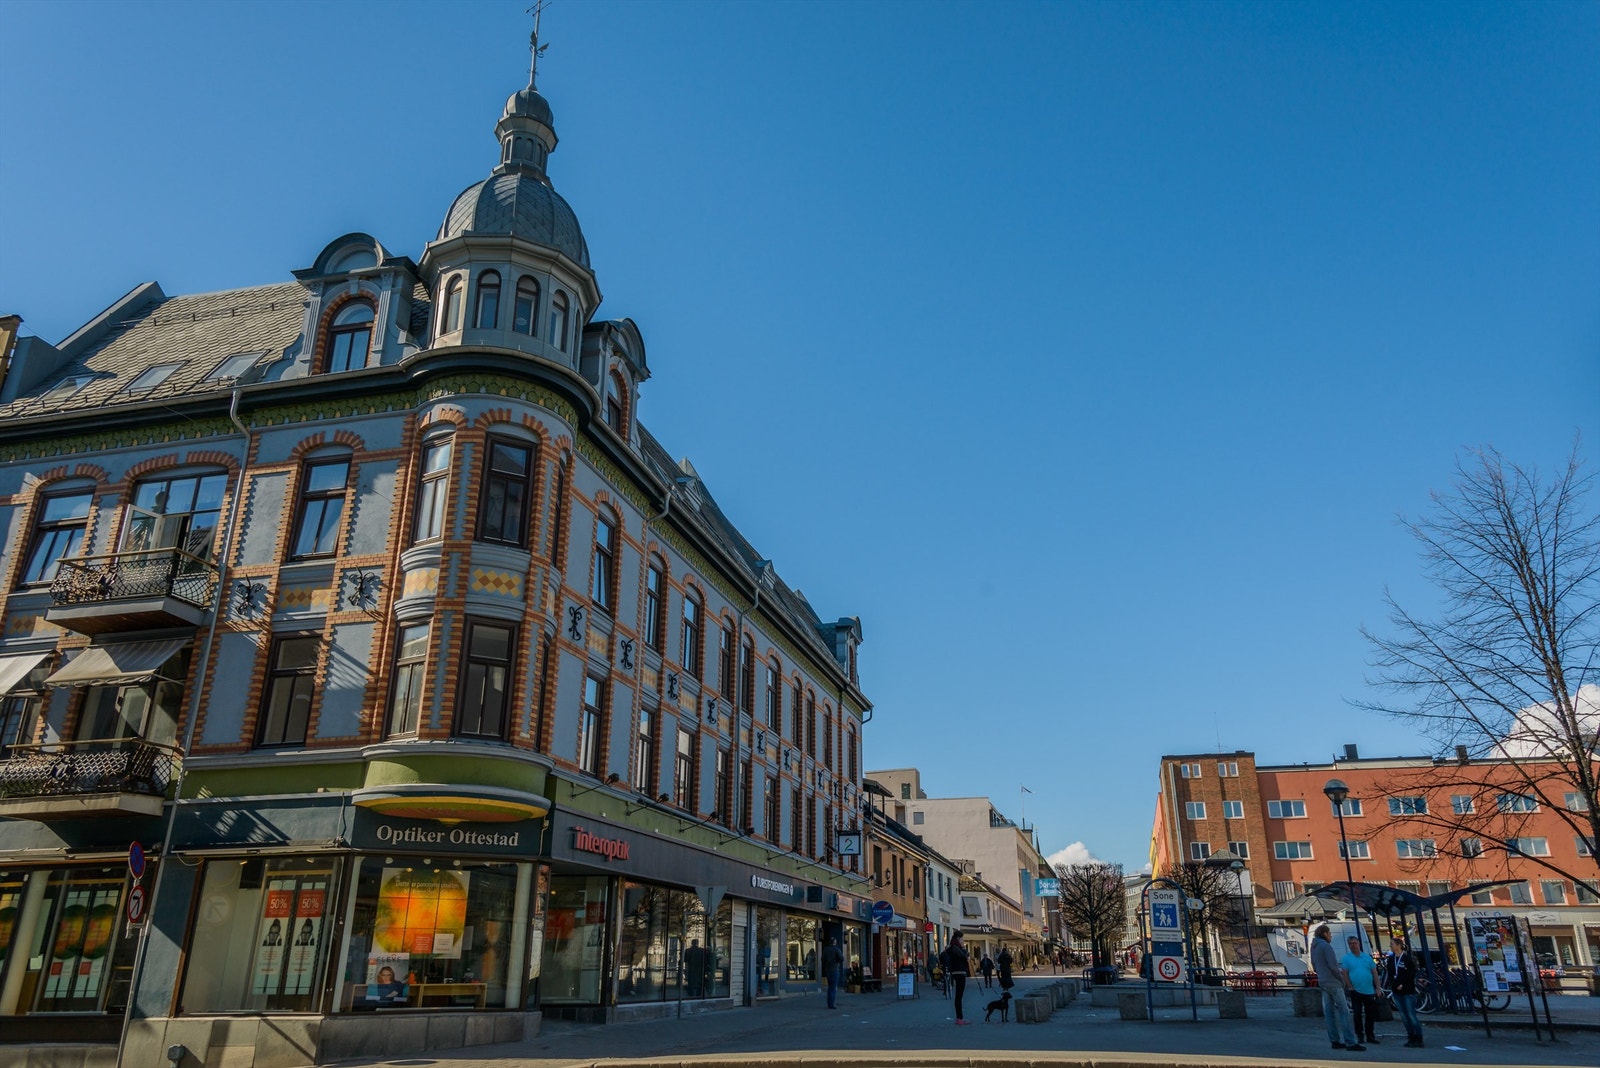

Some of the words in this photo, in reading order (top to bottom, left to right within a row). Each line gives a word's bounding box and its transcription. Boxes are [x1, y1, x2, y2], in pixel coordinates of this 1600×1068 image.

[376, 825, 445, 845] Optiker
[449, 829, 519, 847] Ottestad
[1153, 891, 1174, 900] Sone
[270, 898, 288, 909] 50%
[302, 897, 320, 909] 50%
